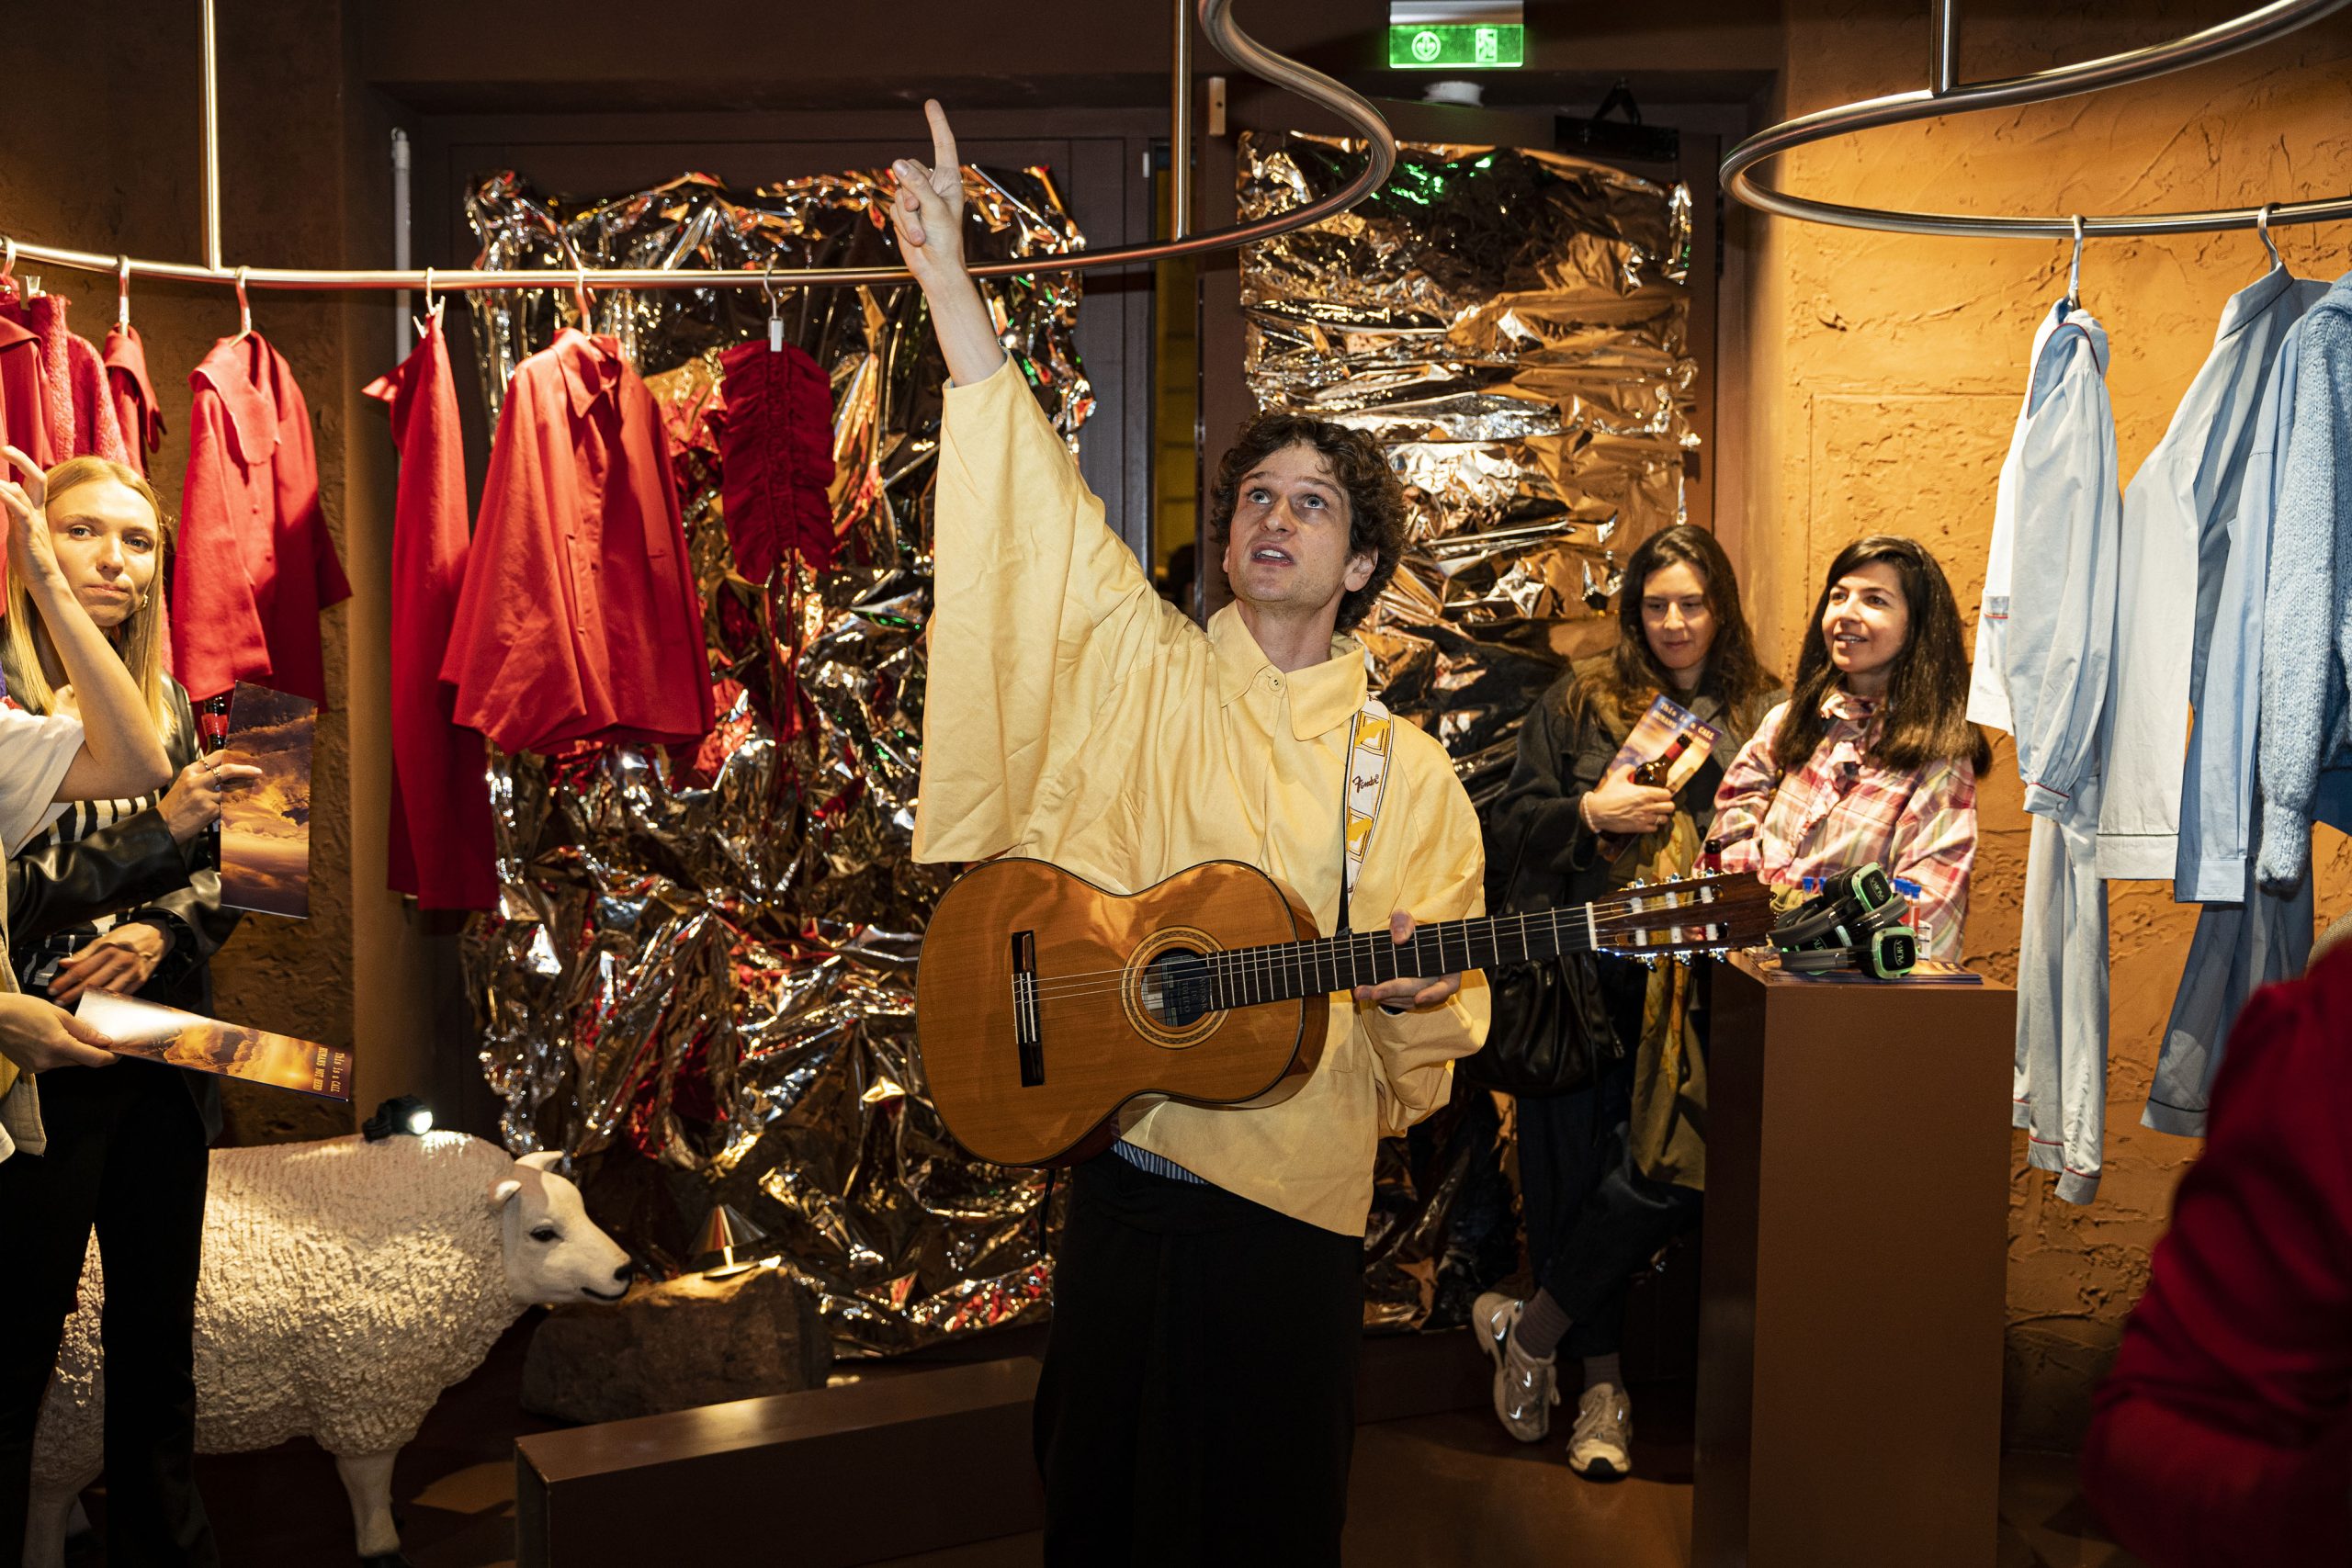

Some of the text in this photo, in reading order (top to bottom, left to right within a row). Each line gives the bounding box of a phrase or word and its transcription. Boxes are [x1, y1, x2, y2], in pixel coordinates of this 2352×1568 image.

[1659, 702, 1678, 717] This
[1679, 714, 1689, 724] is
[1697, 726, 1715, 740] CALL
[334, 1052, 345, 1066] This
[330, 1080, 342, 1093] CALL
